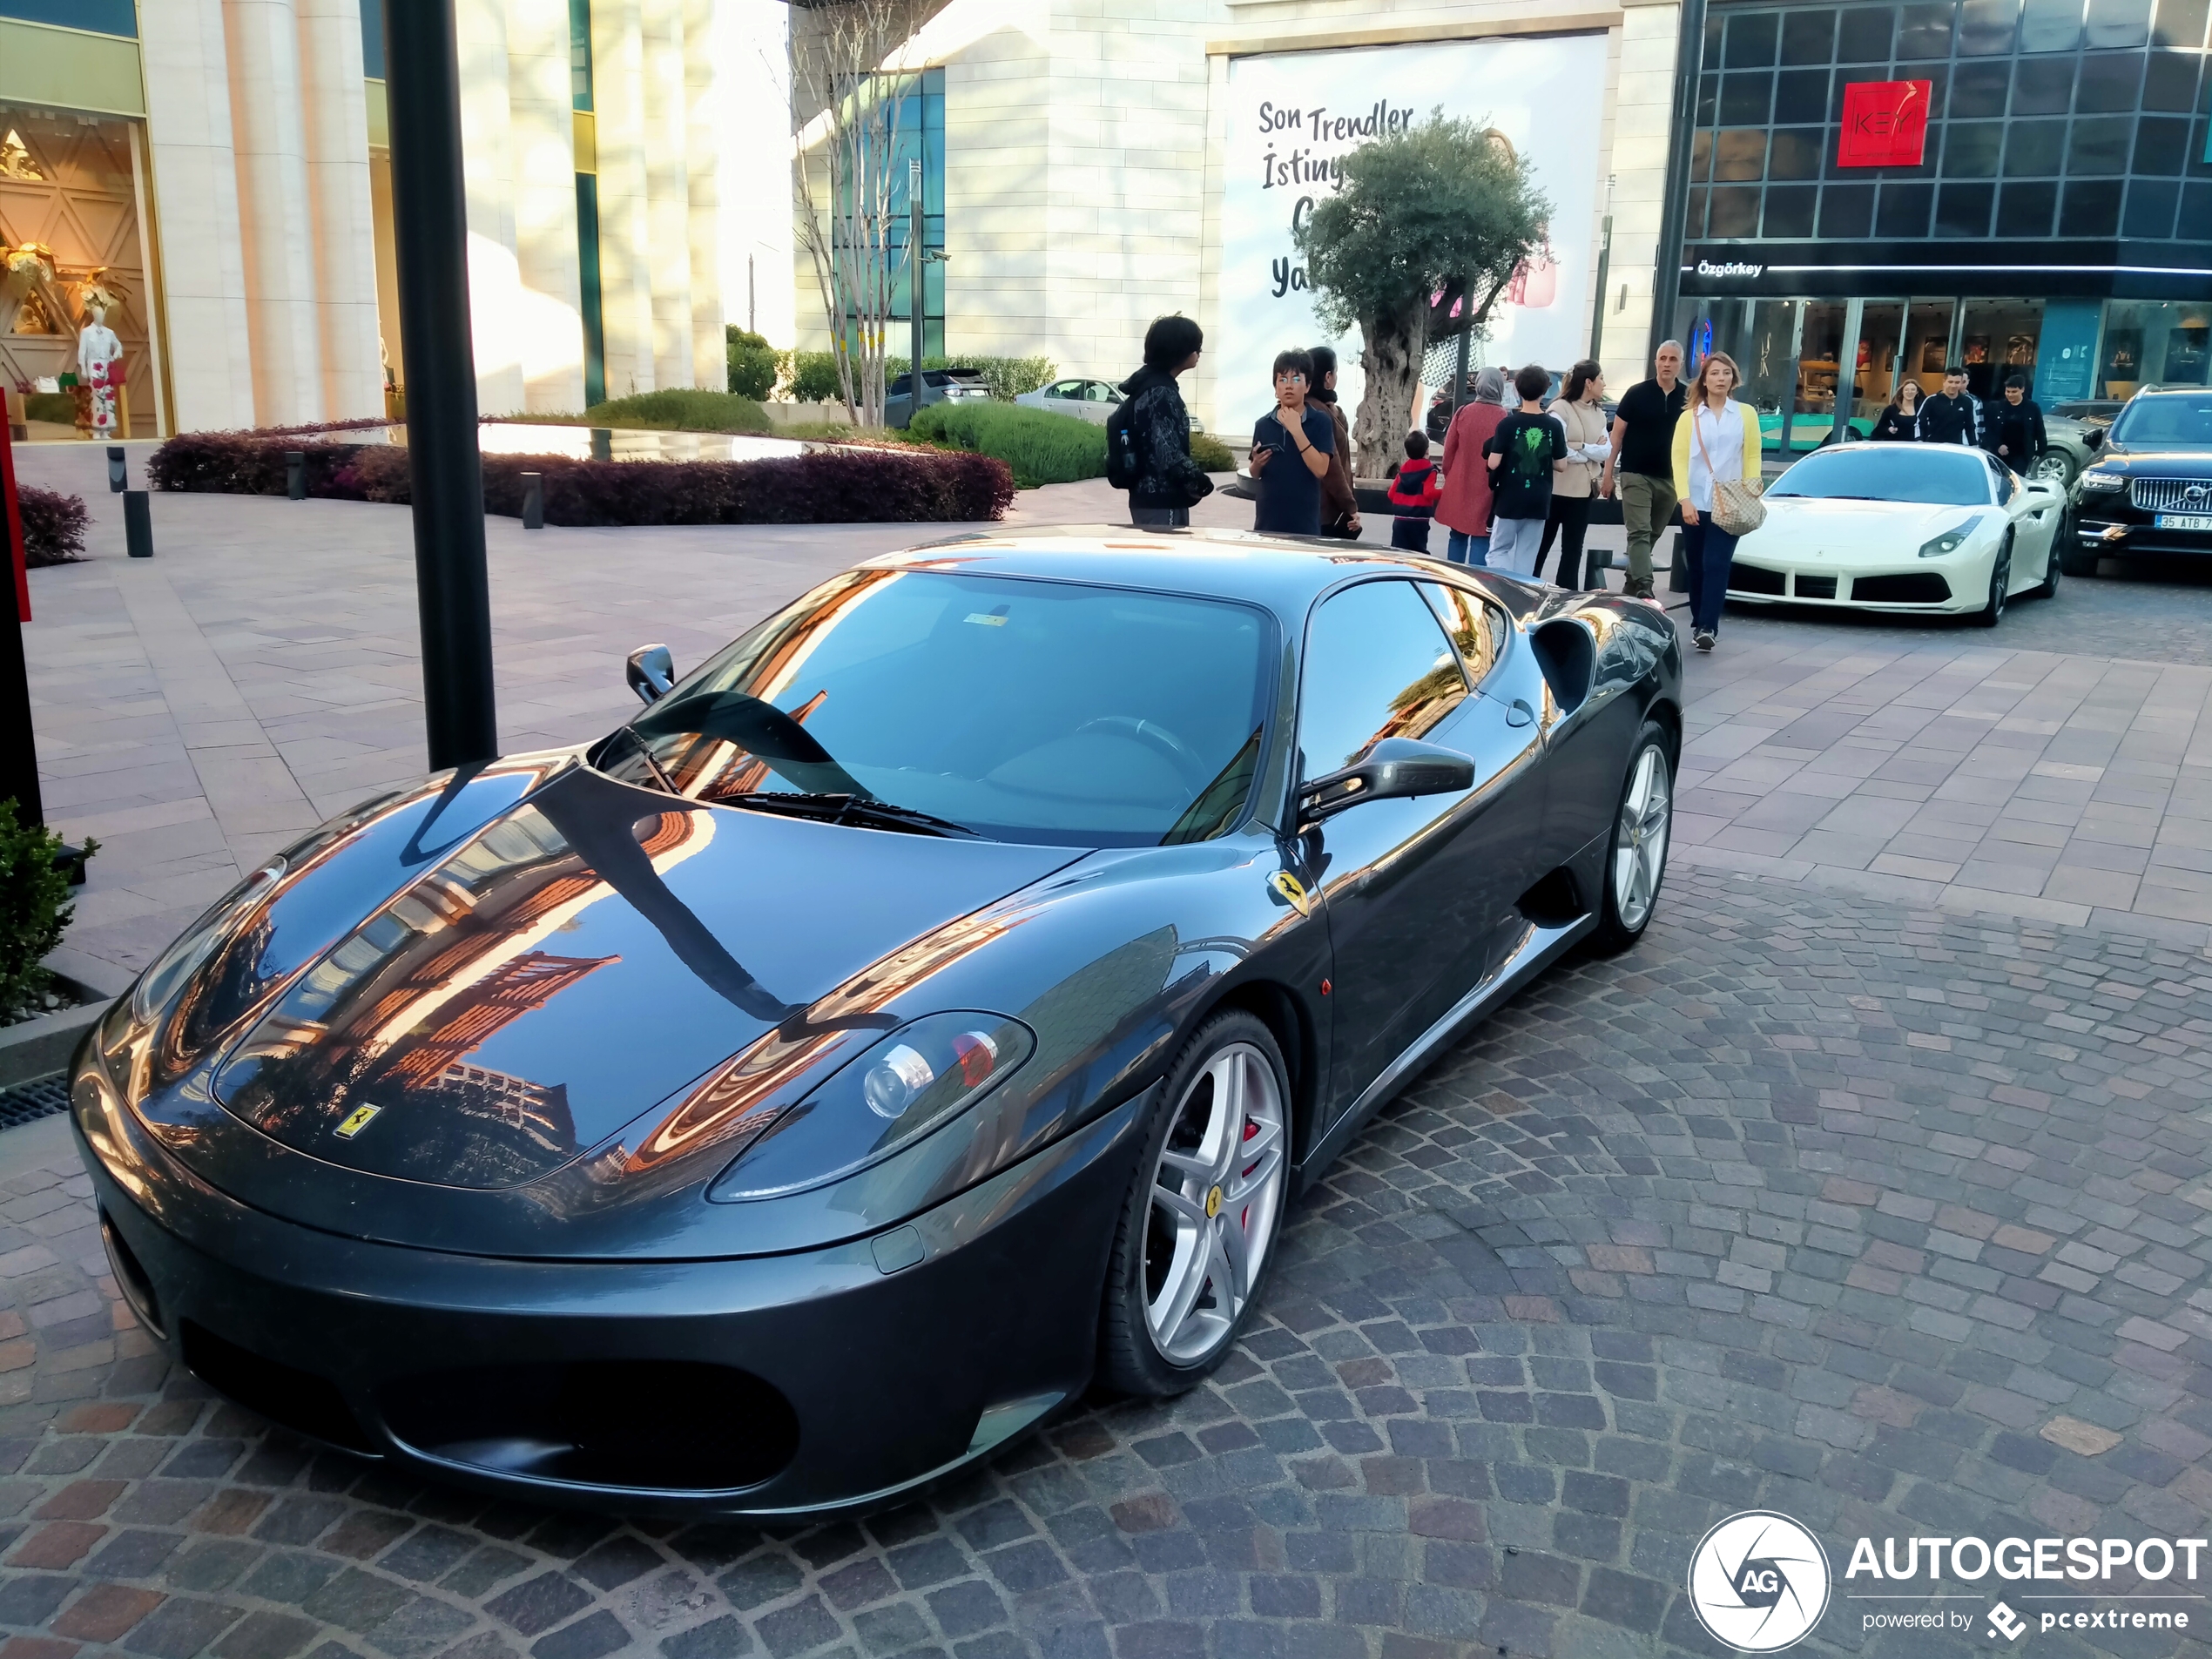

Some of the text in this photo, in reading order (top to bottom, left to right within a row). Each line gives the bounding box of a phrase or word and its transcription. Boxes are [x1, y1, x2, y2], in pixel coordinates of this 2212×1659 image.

[1259, 98, 1413, 142] Son Trendler
[1855, 111, 1912, 134] KEY
[1698, 260, 1763, 277] Özgörkey
[2161, 516, 2175, 527] 35
[2181, 517, 2201, 529] ATB
